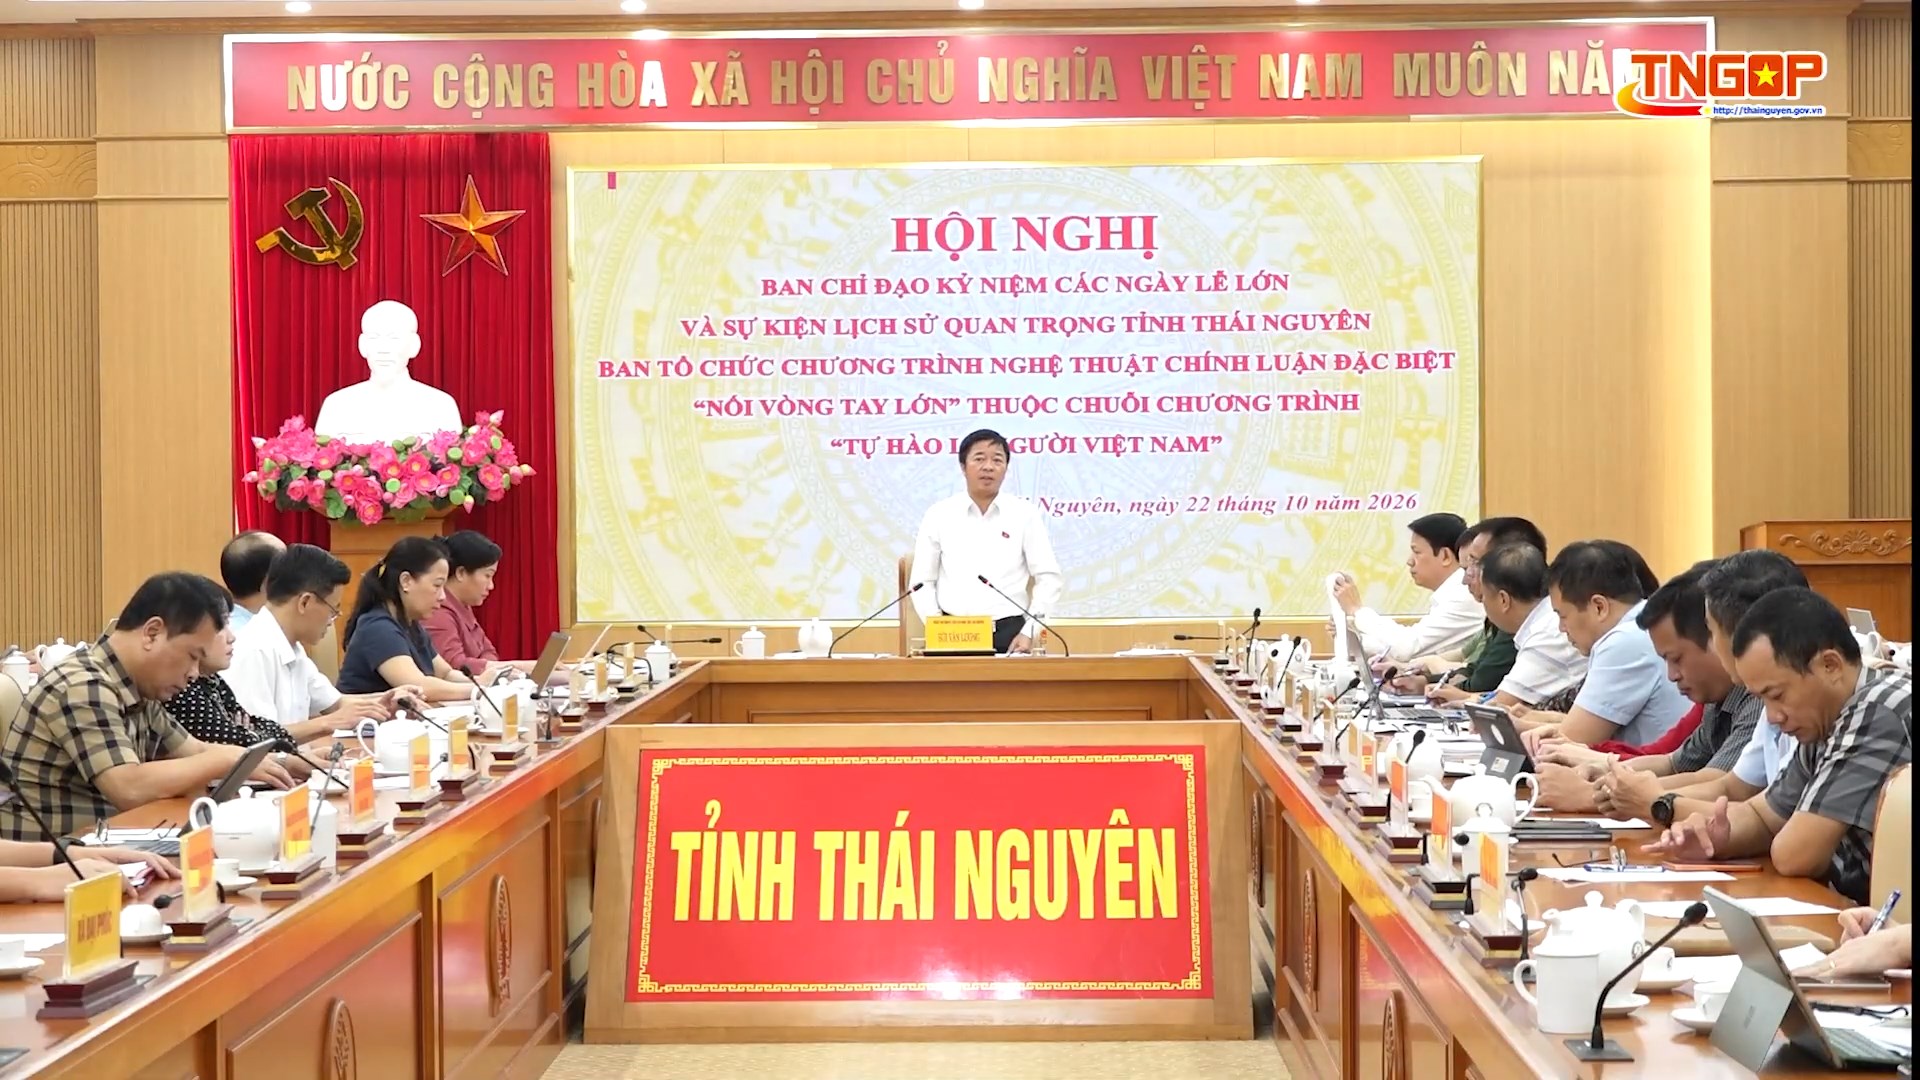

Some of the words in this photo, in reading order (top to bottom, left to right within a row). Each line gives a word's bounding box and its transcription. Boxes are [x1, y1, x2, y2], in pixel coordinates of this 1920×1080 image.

[287, 51, 409, 111] NƯỚC
[433, 53, 554, 118] CỘNG
[578, 50, 668, 107] HÒA
[690, 50, 750, 106] XÃ
[771, 49, 844, 114] HỘI
[867, 40, 955, 104] CHỦ
[978, 46, 1117, 103] NGHĨA
[1142, 44, 1237, 109] VIỆT
[1259, 53, 1363, 99] NAM
[1393, 41, 1528, 97] MUÔN
[892, 212, 996, 261] HỘI
[1012, 216, 1158, 259] NGHỊ
[762, 280, 812, 295] BAN
[821, 274, 867, 294] CHỈ
[875, 278, 929, 298] ĐẠO
[937, 273, 973, 293] KỶ
[981, 275, 1046, 297] NIỆM
[1055, 272, 1108, 292] CÁC
[1116, 271, 1188, 292] NGÀY
[1196, 271, 1228, 291] LỄ
[1236, 270, 1288, 291] LỚN
[681, 316, 716, 336] VÀ
[724, 317, 757, 340] SỰ
[764, 317, 825, 339] KIỆN
[835, 319, 896, 339] LỊCH
[904, 313, 938, 334] SỬ
[944, 318, 1016, 337] QUAN
[1024, 317, 1114, 337] TRỌNG
[1122, 312, 1184, 332] TỈNH
[1192, 311, 1255, 331] THÁI
[1263, 309, 1370, 330] NGUYÊN
[599, 361, 649, 377] BAN
[700, 355, 773, 376] CHỨC
[782, 357, 895, 375] CHƯƠNG
[902, 353, 982, 374] TRÌNH
[991, 355, 1062, 377] NGHỆ
[1070, 354, 1158, 376] THUẬT
[1165, 351, 1249, 372] CHÍNH
[1257, 352, 1326, 375] LUẬN
[1334, 352, 1388, 374] ĐẶC
[1396, 350, 1455, 373] BIỆT
[694, 395, 752, 416] “NỐI
[760, 395, 833, 415] VÒNG
[840, 399, 888, 414] TAY
[895, 394, 960, 414] LỚN”
[967, 395, 1057, 417] THUỘC
[1066, 392, 1149, 413] CHUỖI
[1157, 394, 1270, 412] CHƯƠNG
[1278, 390, 1358, 411] TRÌNH
[831, 436, 880, 459] “TỰ
[887, 434, 942, 454] HÀO
[1005, 433, 1076, 454] GƯỜI
[1084, 434, 1143, 457] VIỆT
[1151, 436, 1222, 452] NAM”
[1041, 497, 1120, 516] Nguyên,
[1130, 497, 1178, 516] ngày
[1187, 497, 1209, 511] 22
[1218, 496, 1275, 514] tháng
[1287, 496, 1307, 510] 10
[1316, 496, 1359, 509] năm
[1368, 495, 1416, 509] 2026
[671, 799, 796, 922] TỈNH
[813, 811, 935, 922] THÁI
[954, 808, 1179, 921] NGUYÊN
